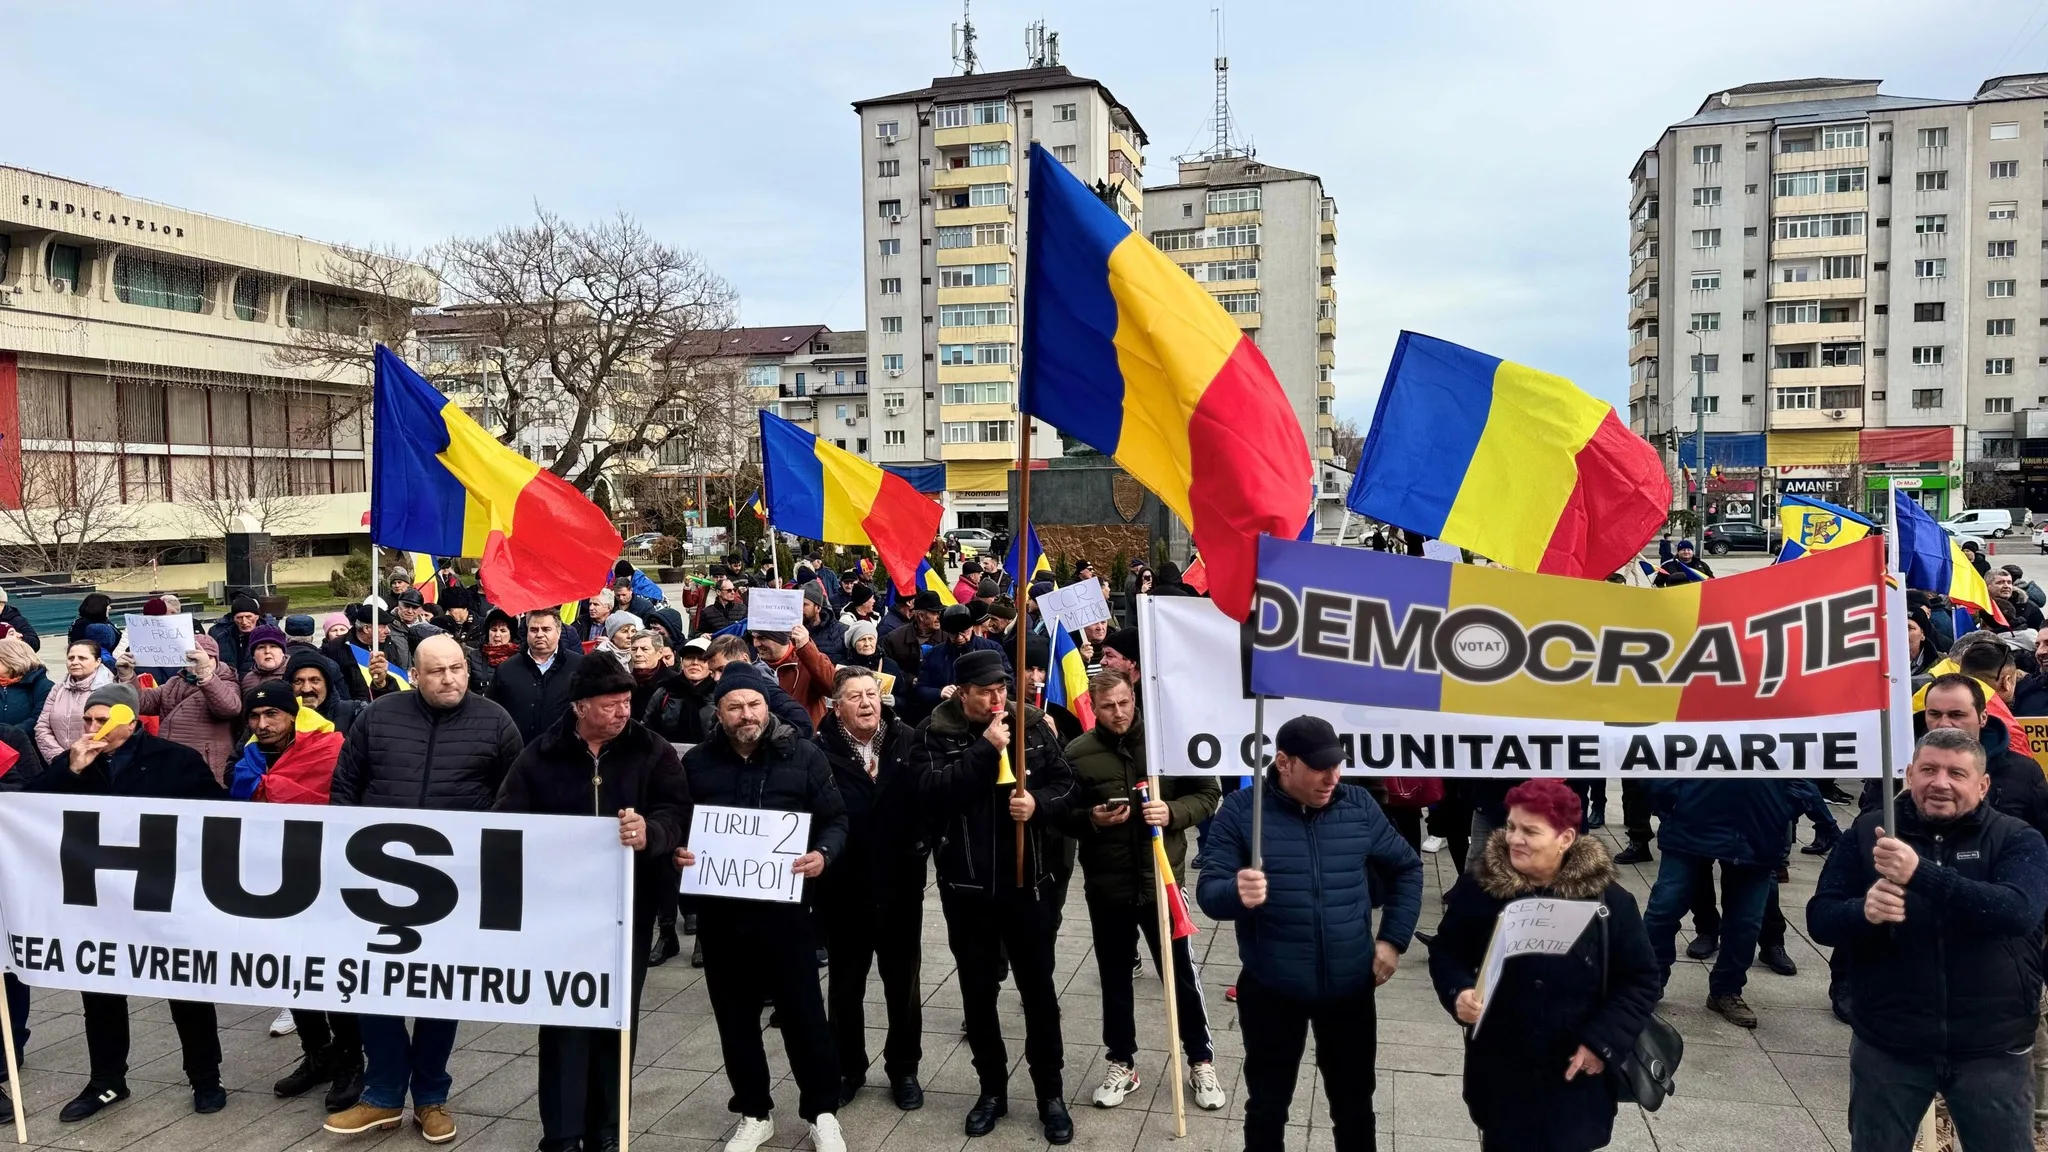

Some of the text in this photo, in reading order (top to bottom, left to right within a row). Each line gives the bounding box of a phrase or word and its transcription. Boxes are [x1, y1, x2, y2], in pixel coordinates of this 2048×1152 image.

[22, 194, 184, 238] SINDICATELOR
[1785, 481, 1841, 492] AMANET
[1047, 583, 1095, 612] CCR
[1458, 641, 1502, 652] VOTAT
[1188, 731, 1858, 771] O CUNITATE APARTE
[700, 811, 802, 855] TURUL 2
[7, 930, 65, 973] EEA
[76, 940, 117, 977] CE
[128, 943, 218, 985] VREM
[383, 960, 531, 1005] PENTRU
[545, 970, 610, 1009] VOI
